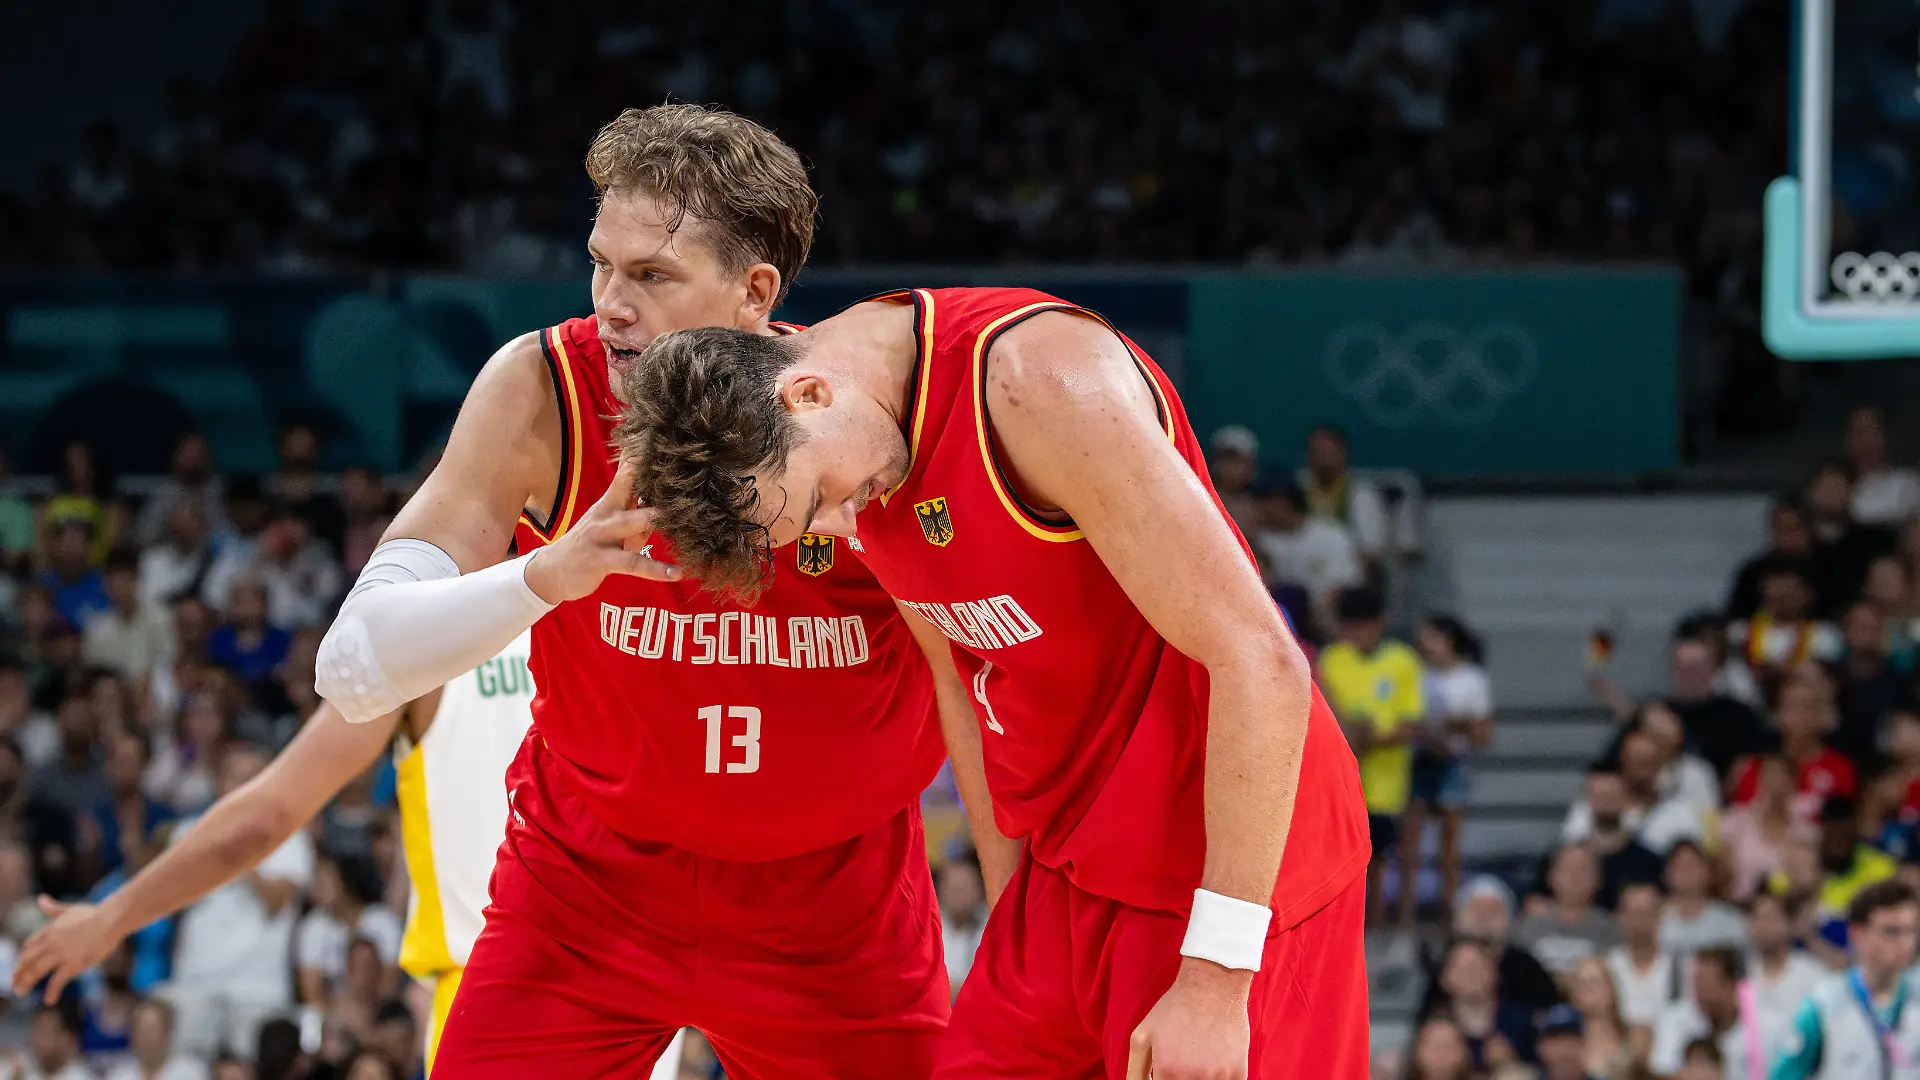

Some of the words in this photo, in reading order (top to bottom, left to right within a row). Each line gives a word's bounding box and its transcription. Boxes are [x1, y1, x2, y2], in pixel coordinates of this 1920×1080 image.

[600, 601, 869, 669] DEUTSCHLAND
[973, 660, 1004, 736] 9
[697, 704, 762, 774] 13
